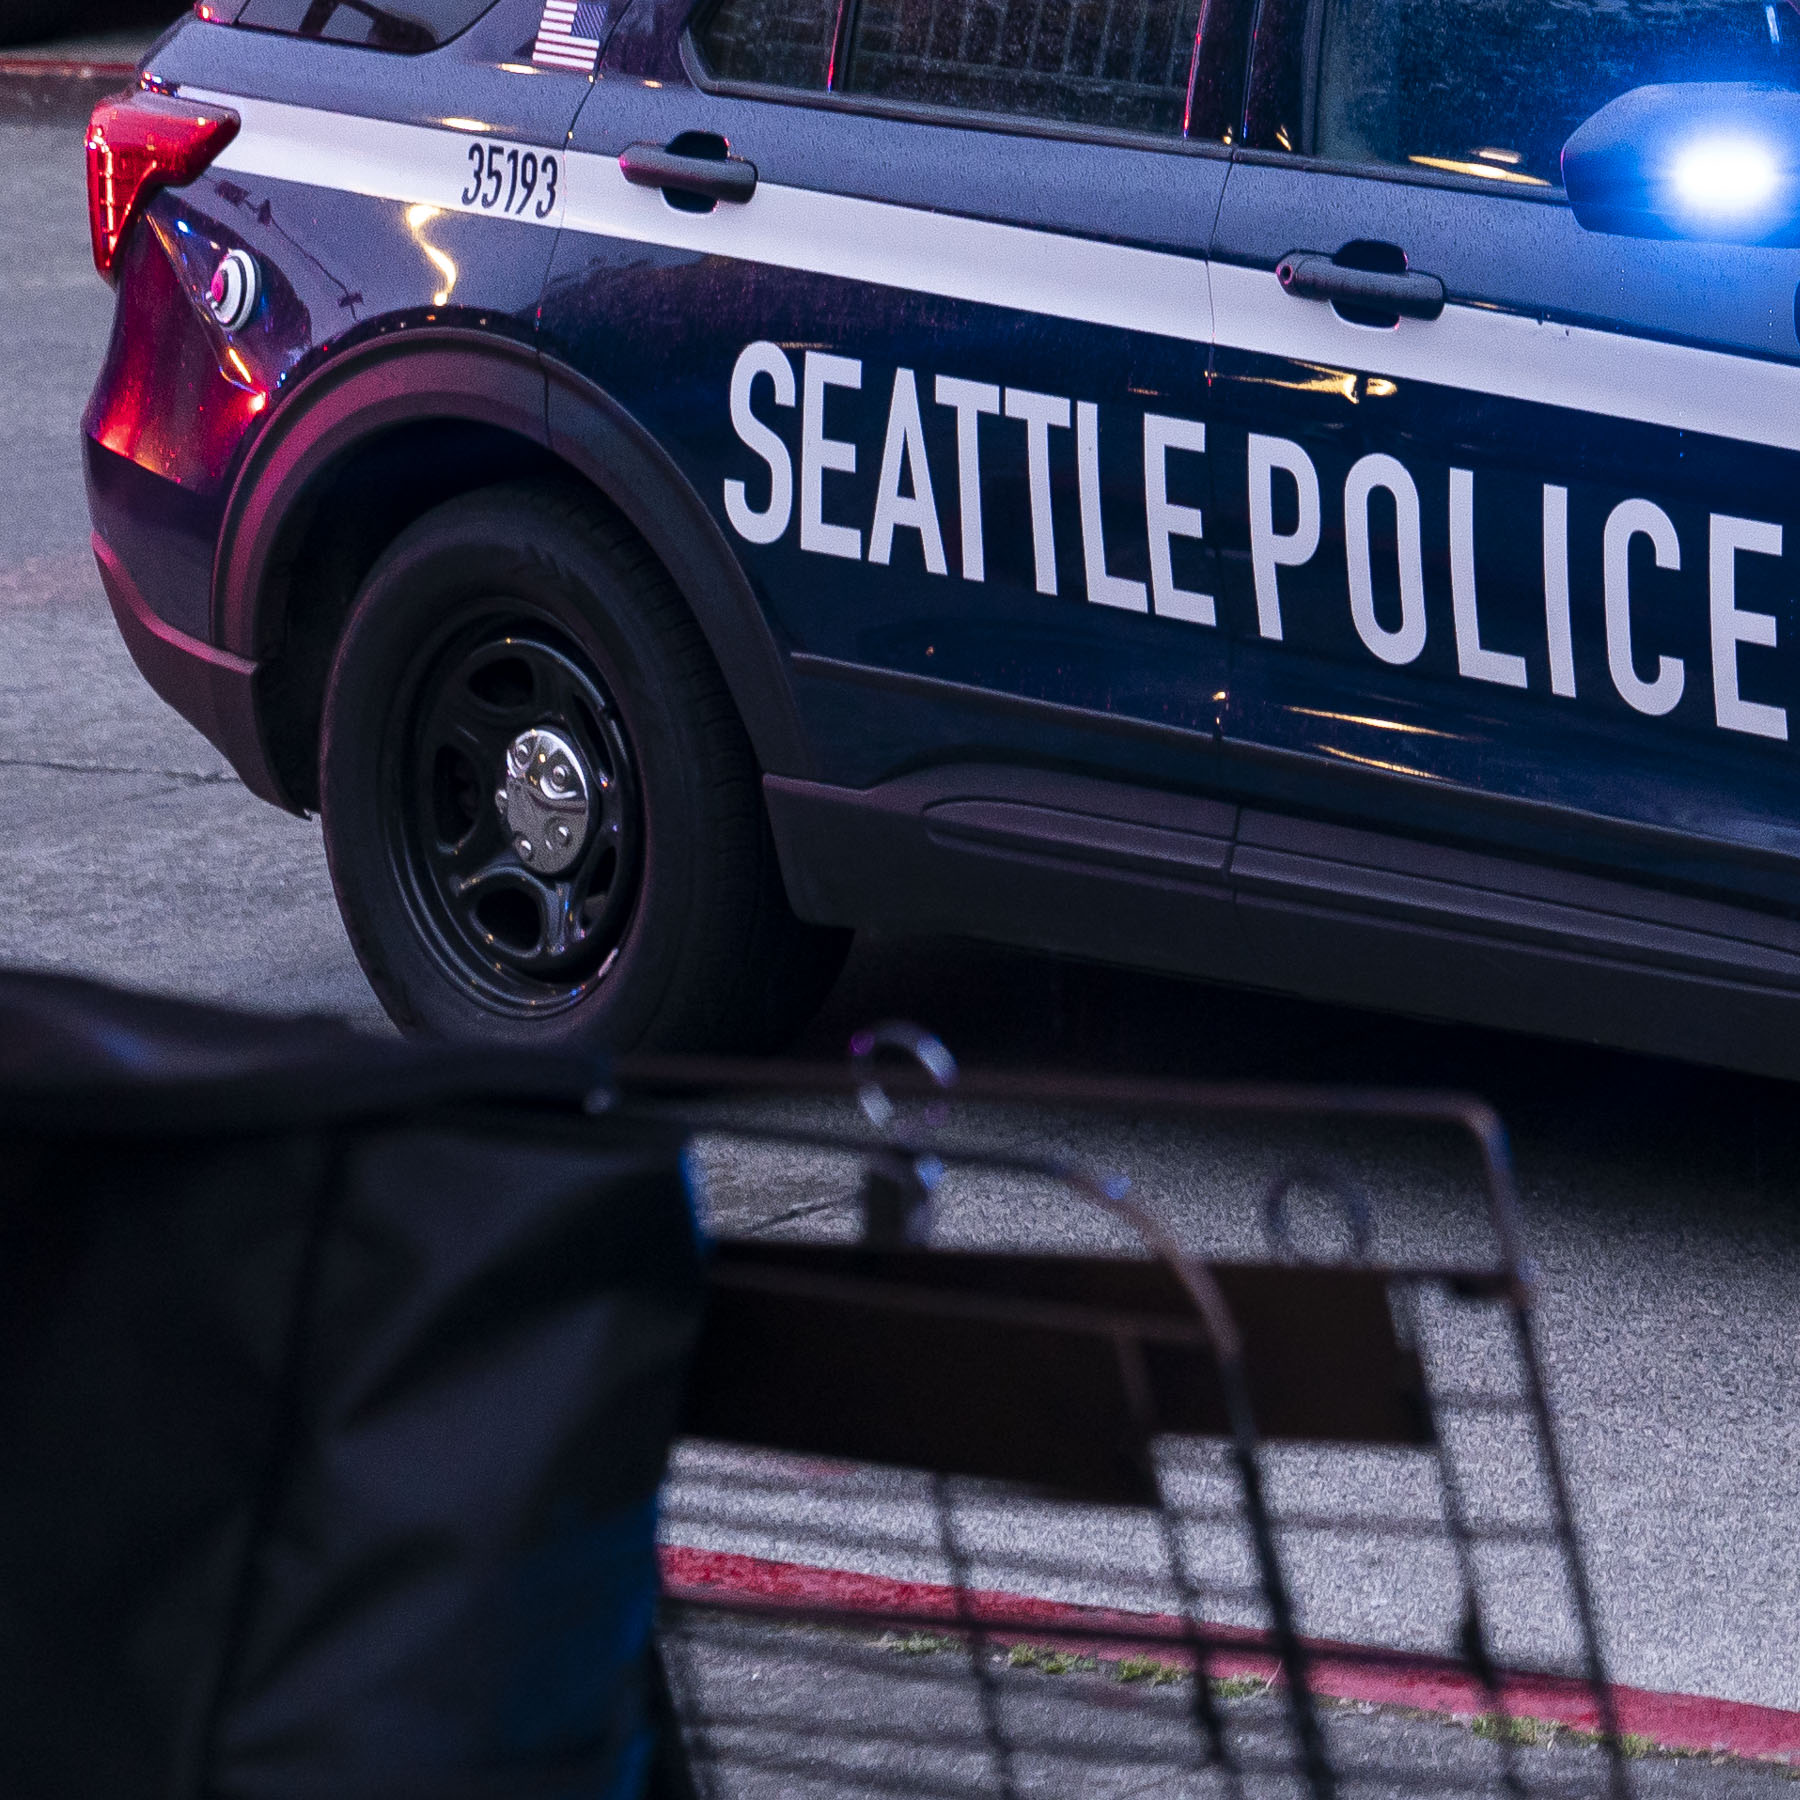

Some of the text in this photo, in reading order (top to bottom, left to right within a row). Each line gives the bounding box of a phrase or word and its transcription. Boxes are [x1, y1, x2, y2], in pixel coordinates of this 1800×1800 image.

[461, 143, 558, 219] 35193
[724, 340, 1790, 741] SEATTLE POLICE
